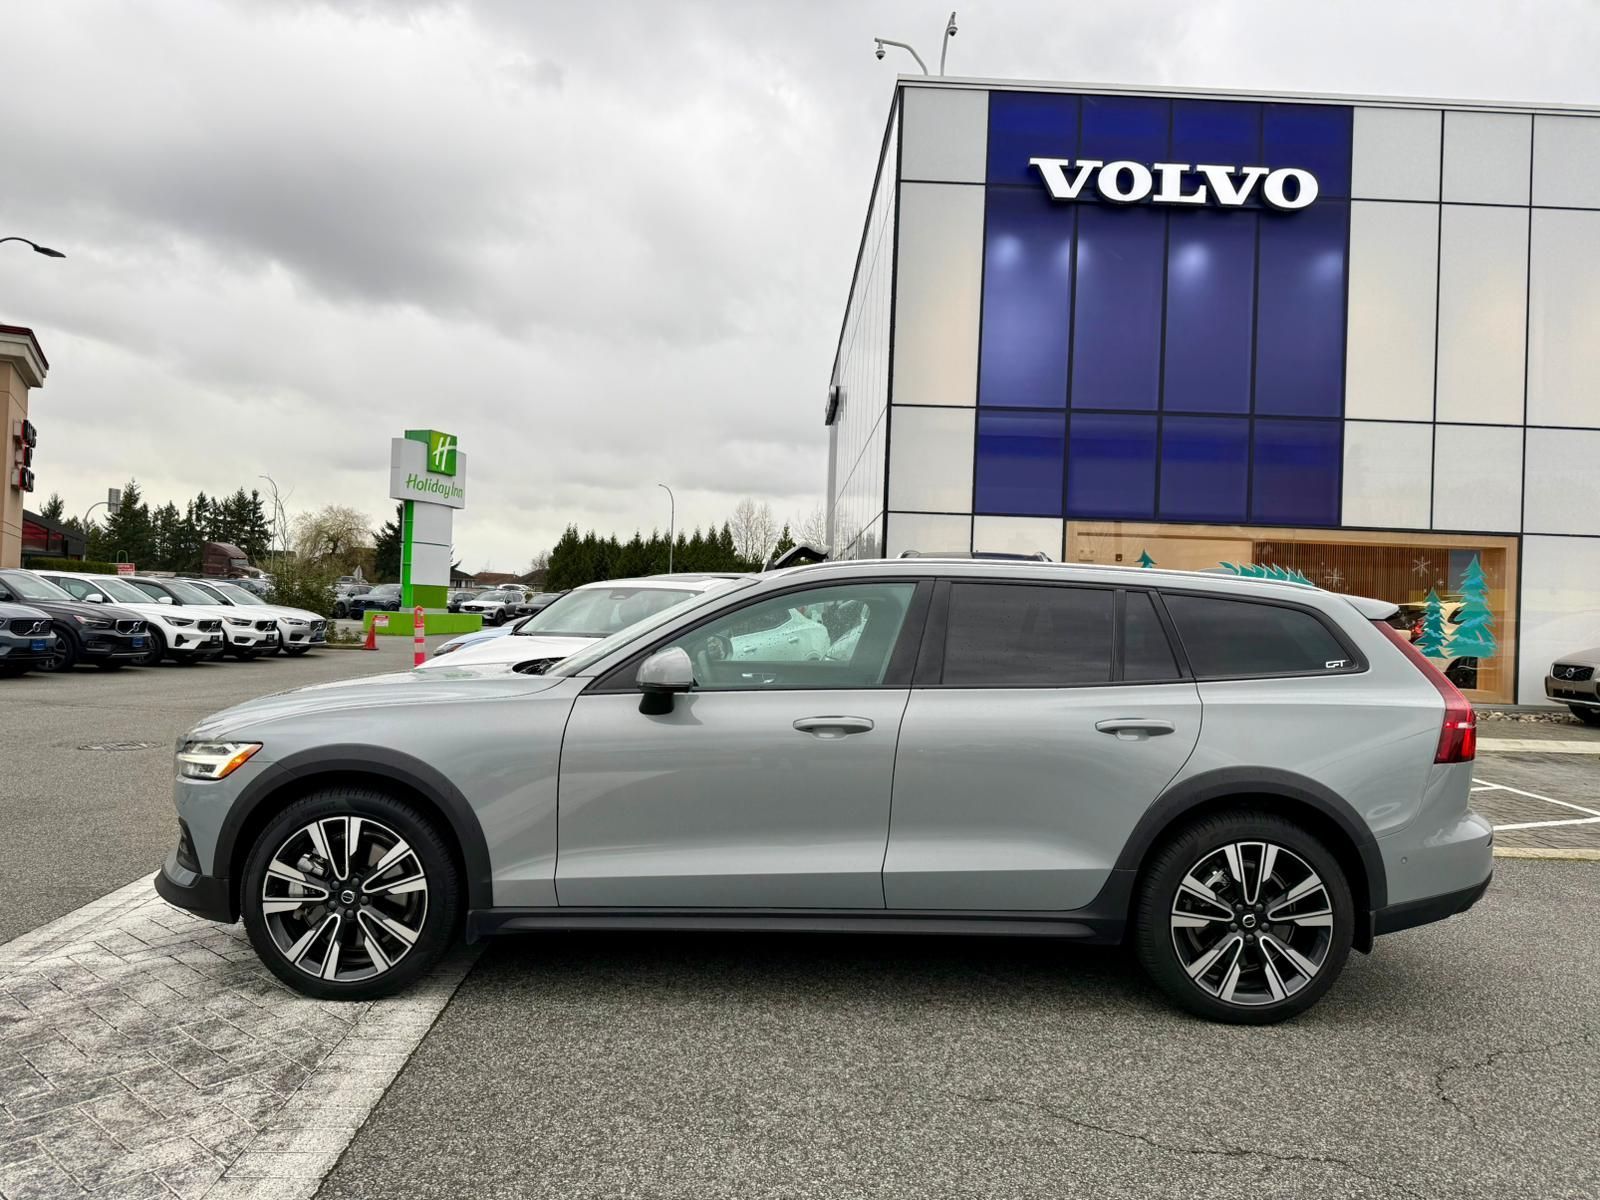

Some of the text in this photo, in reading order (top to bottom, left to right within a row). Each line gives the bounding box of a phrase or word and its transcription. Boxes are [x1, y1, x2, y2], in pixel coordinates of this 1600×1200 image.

[1029, 157, 1318, 210] VOLVO
[406, 473, 464, 499] Holiday Inn
